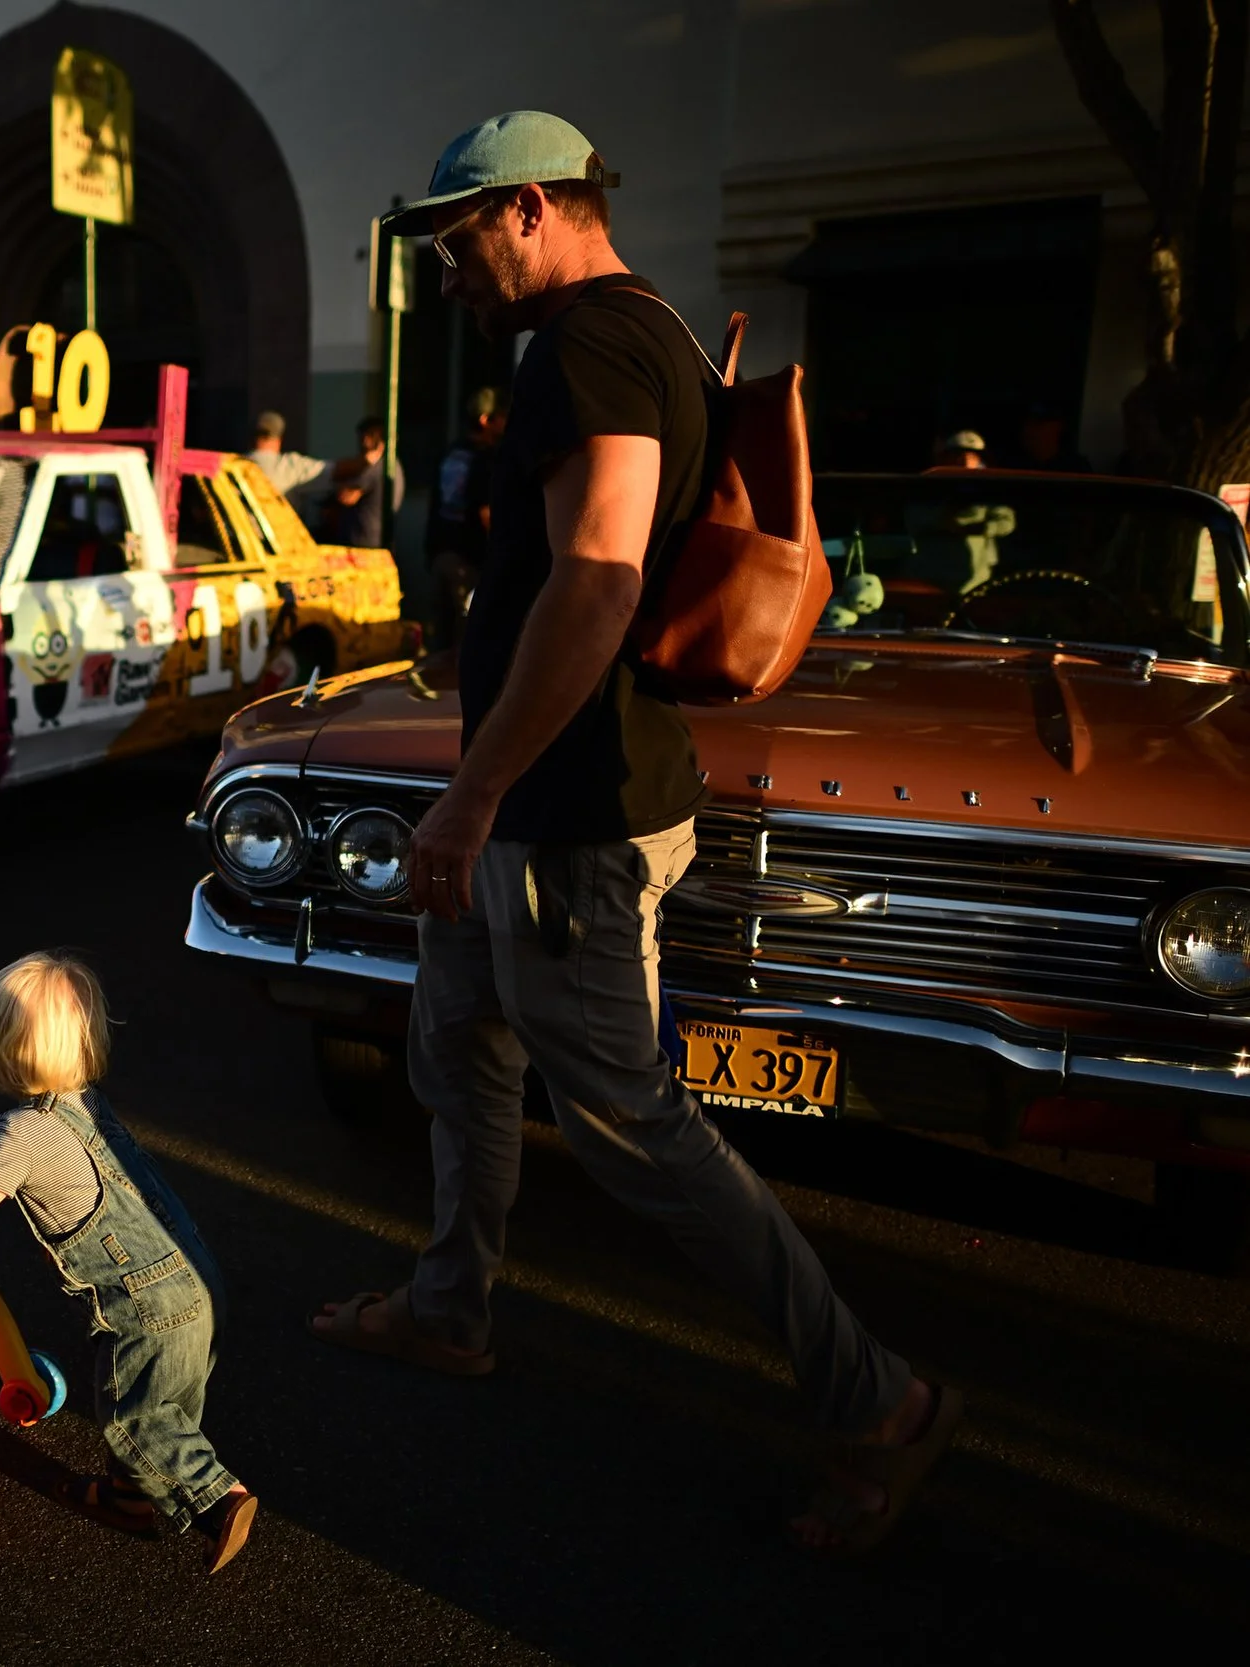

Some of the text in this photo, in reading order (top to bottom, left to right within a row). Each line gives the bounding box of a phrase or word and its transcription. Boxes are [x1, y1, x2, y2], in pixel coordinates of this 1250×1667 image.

[188, 581, 270, 697] 10
[752, 1049, 832, 1098] 397
[702, 1092, 824, 1118] IMPALA
